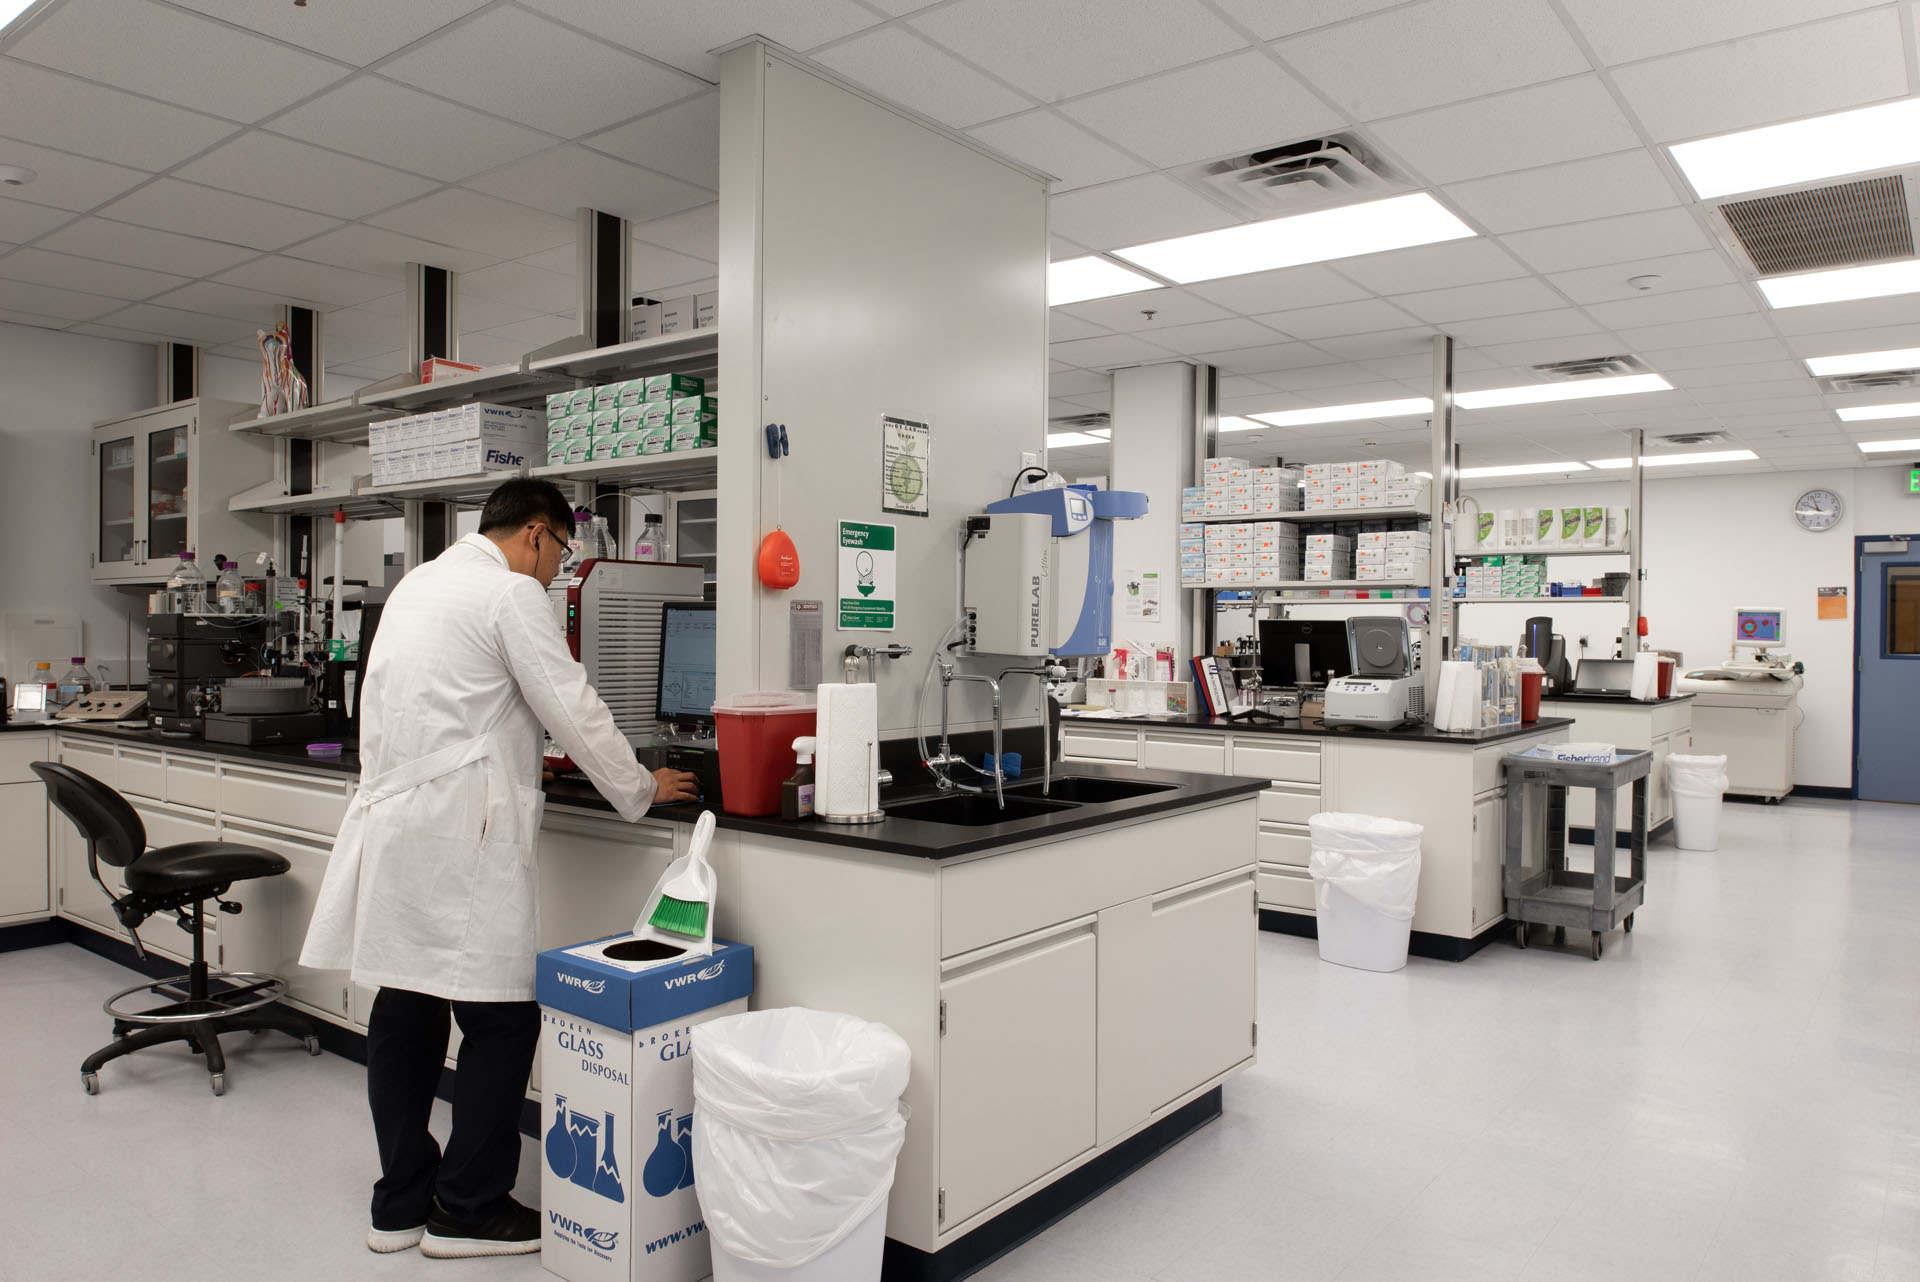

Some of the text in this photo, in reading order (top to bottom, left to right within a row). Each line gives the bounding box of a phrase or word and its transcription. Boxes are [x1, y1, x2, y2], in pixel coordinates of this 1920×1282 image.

[484, 408, 504, 416] VWR
[843, 528, 869, 539] Emergency
[843, 537, 863, 546] Eyewash
[1031, 575, 1040, 648] PURELAB
[557, 972, 582, 988] VWR
[664, 973, 697, 990] VWR
[543, 1014, 592, 1035] BROKEN
[557, 1031, 604, 1060] GLASS
[581, 1059, 630, 1086] DISPOSAL
[549, 1209, 583, 1238] VWR
